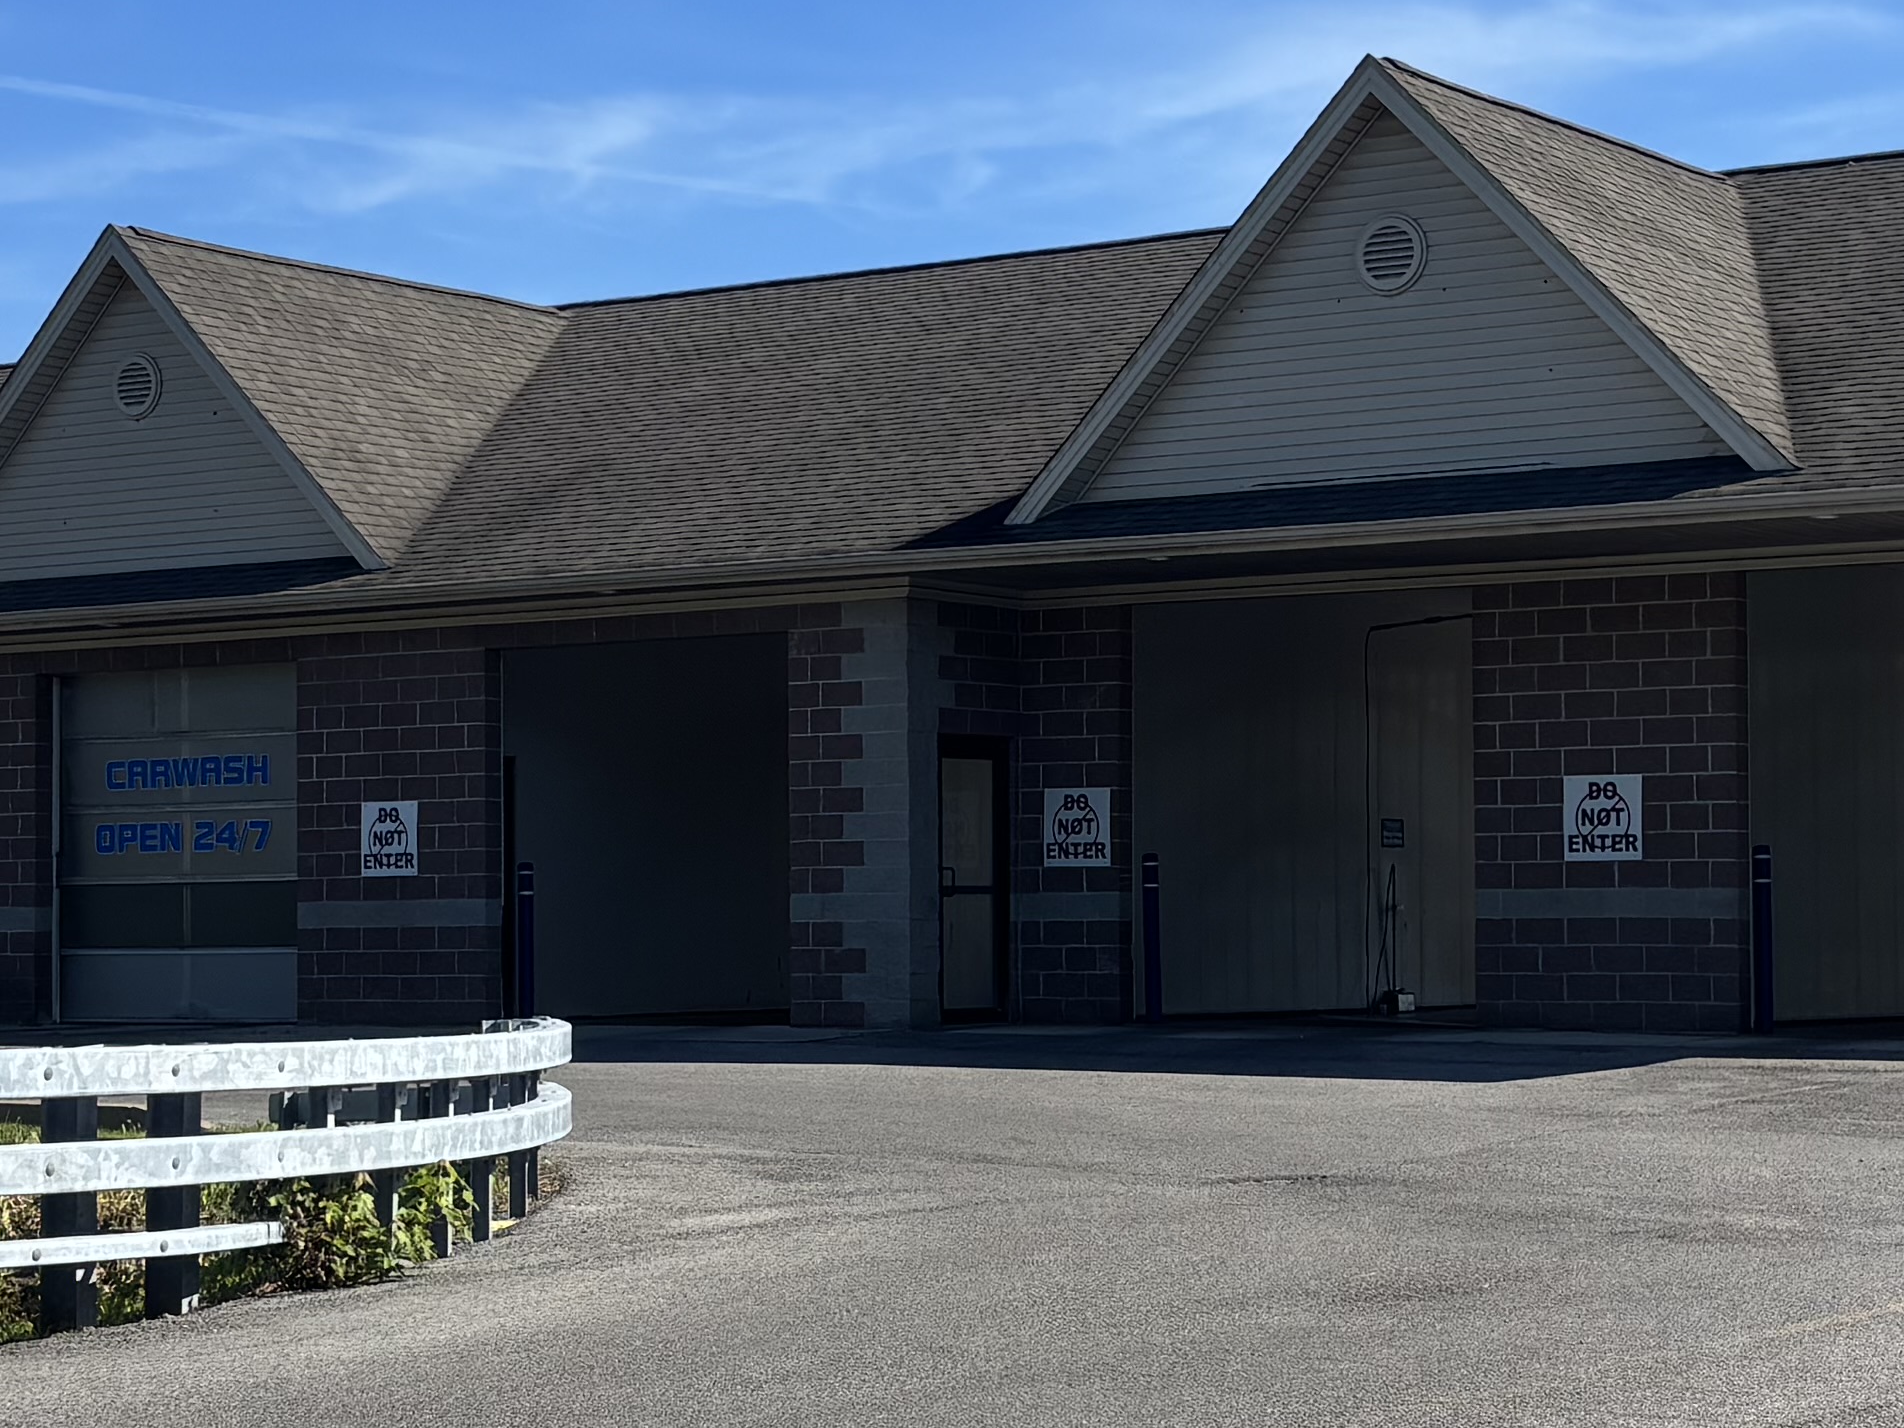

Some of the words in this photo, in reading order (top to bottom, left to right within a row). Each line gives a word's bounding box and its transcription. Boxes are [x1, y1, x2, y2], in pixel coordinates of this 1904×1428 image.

[106, 753, 271, 791] CARWASH
[1589, 781, 1617, 800] DO
[1064, 793, 1089, 811] DO
[378, 807, 400, 824] DO
[1581, 808, 1625, 826] NOT
[1058, 818, 1094, 835] NOT
[95, 821, 182, 855] OPEN
[193, 819, 272, 853] 24/7
[373, 830, 404, 847] NOT
[1568, 833, 1638, 853] ENTER
[1046, 841, 1107, 860] ENTER
[363, 852, 415, 870] ENTER
